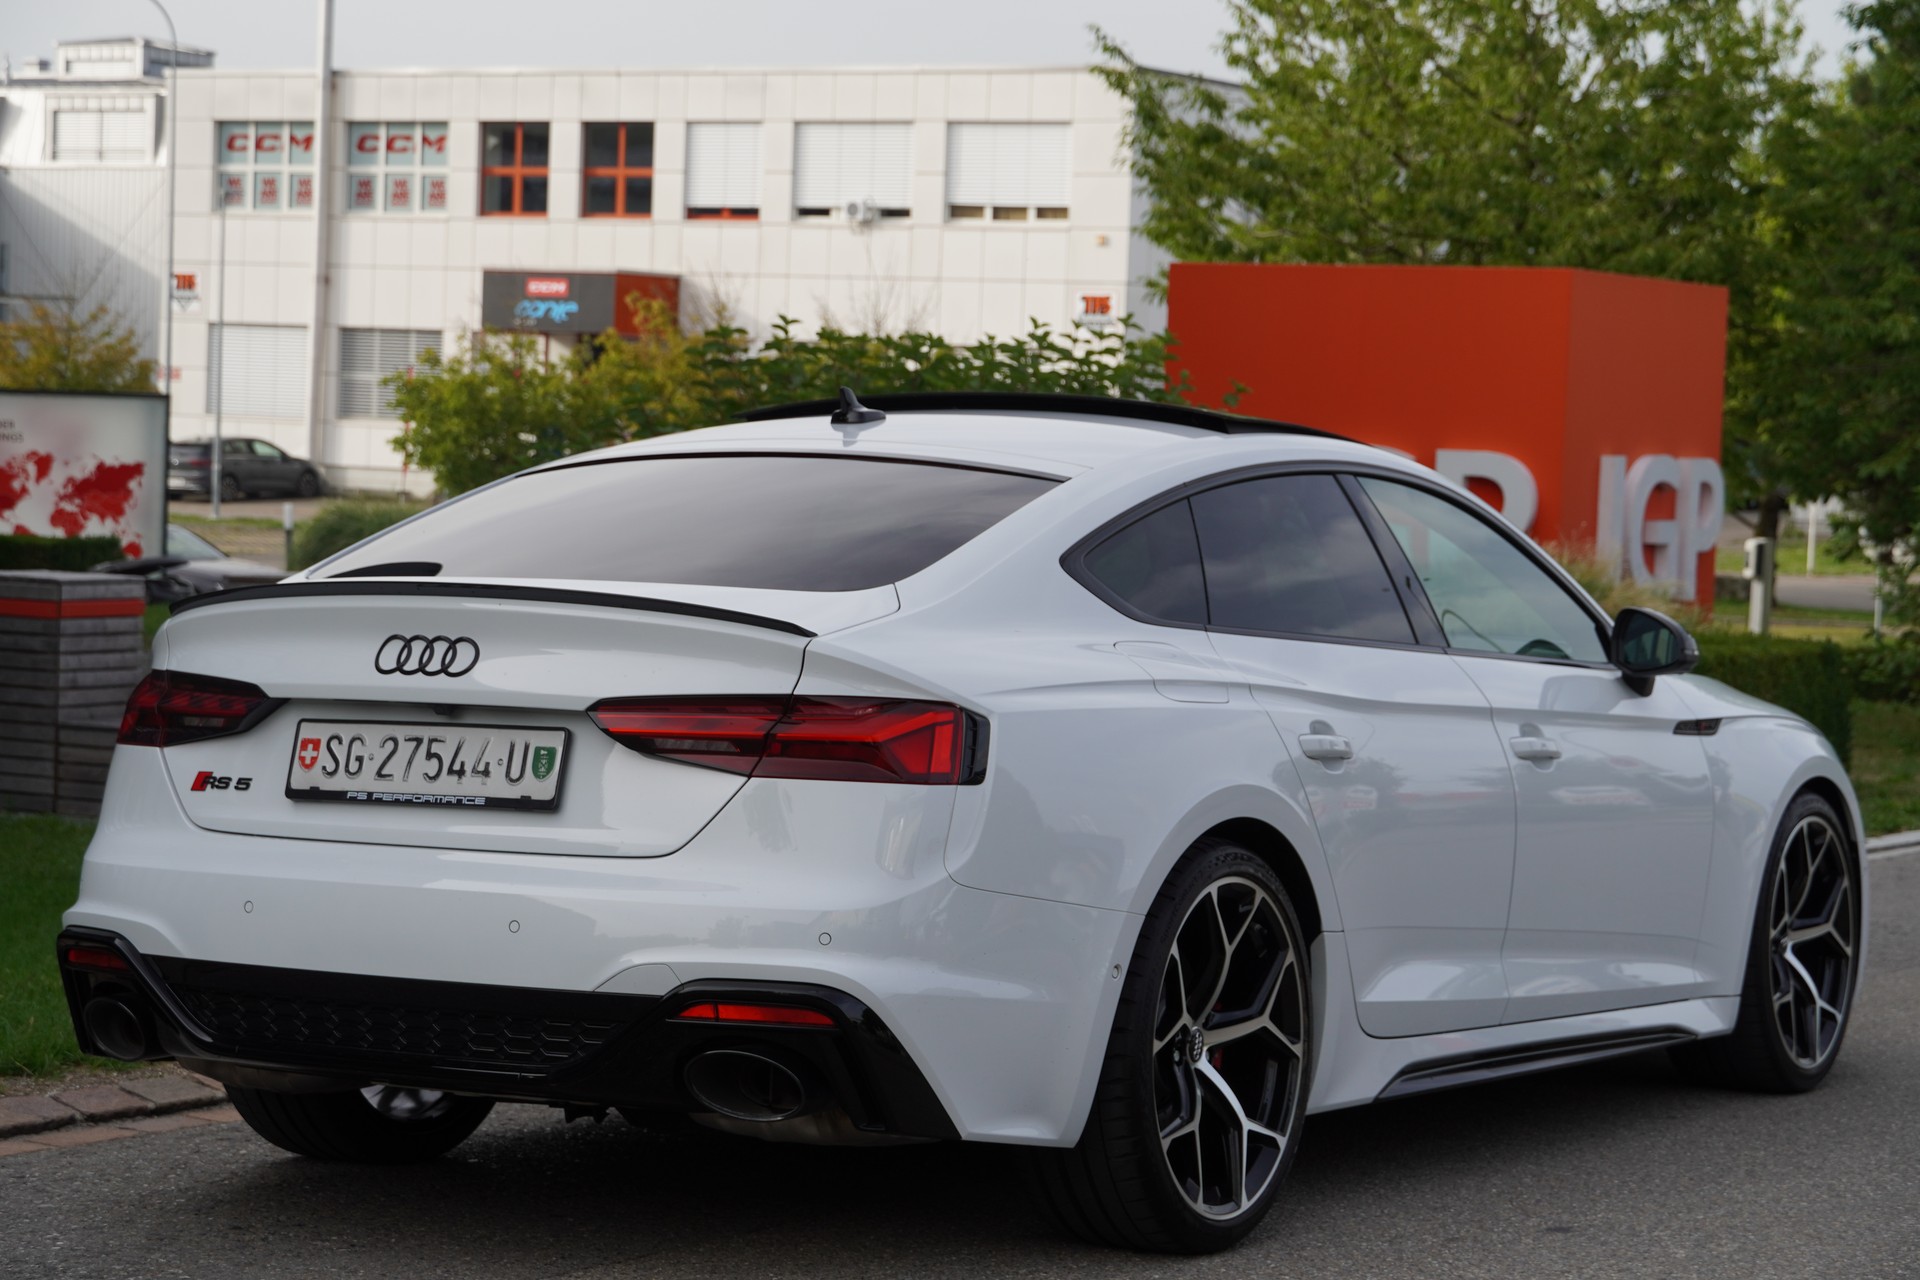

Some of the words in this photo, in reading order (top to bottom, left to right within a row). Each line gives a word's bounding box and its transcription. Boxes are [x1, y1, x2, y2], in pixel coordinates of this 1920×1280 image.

[226, 133, 314, 153] CCM
[355, 133, 447, 154] CCM
[1596, 454, 1725, 601] IGP
[321, 732, 368, 780] SG
[373, 734, 494, 785] 27544
[504, 738, 531, 786] U
[200, 775, 233, 790] RS
[234, 777, 253, 791] 5
[346, 791, 368, 800] PS
[372, 792, 486, 806] PERFORMANCE
